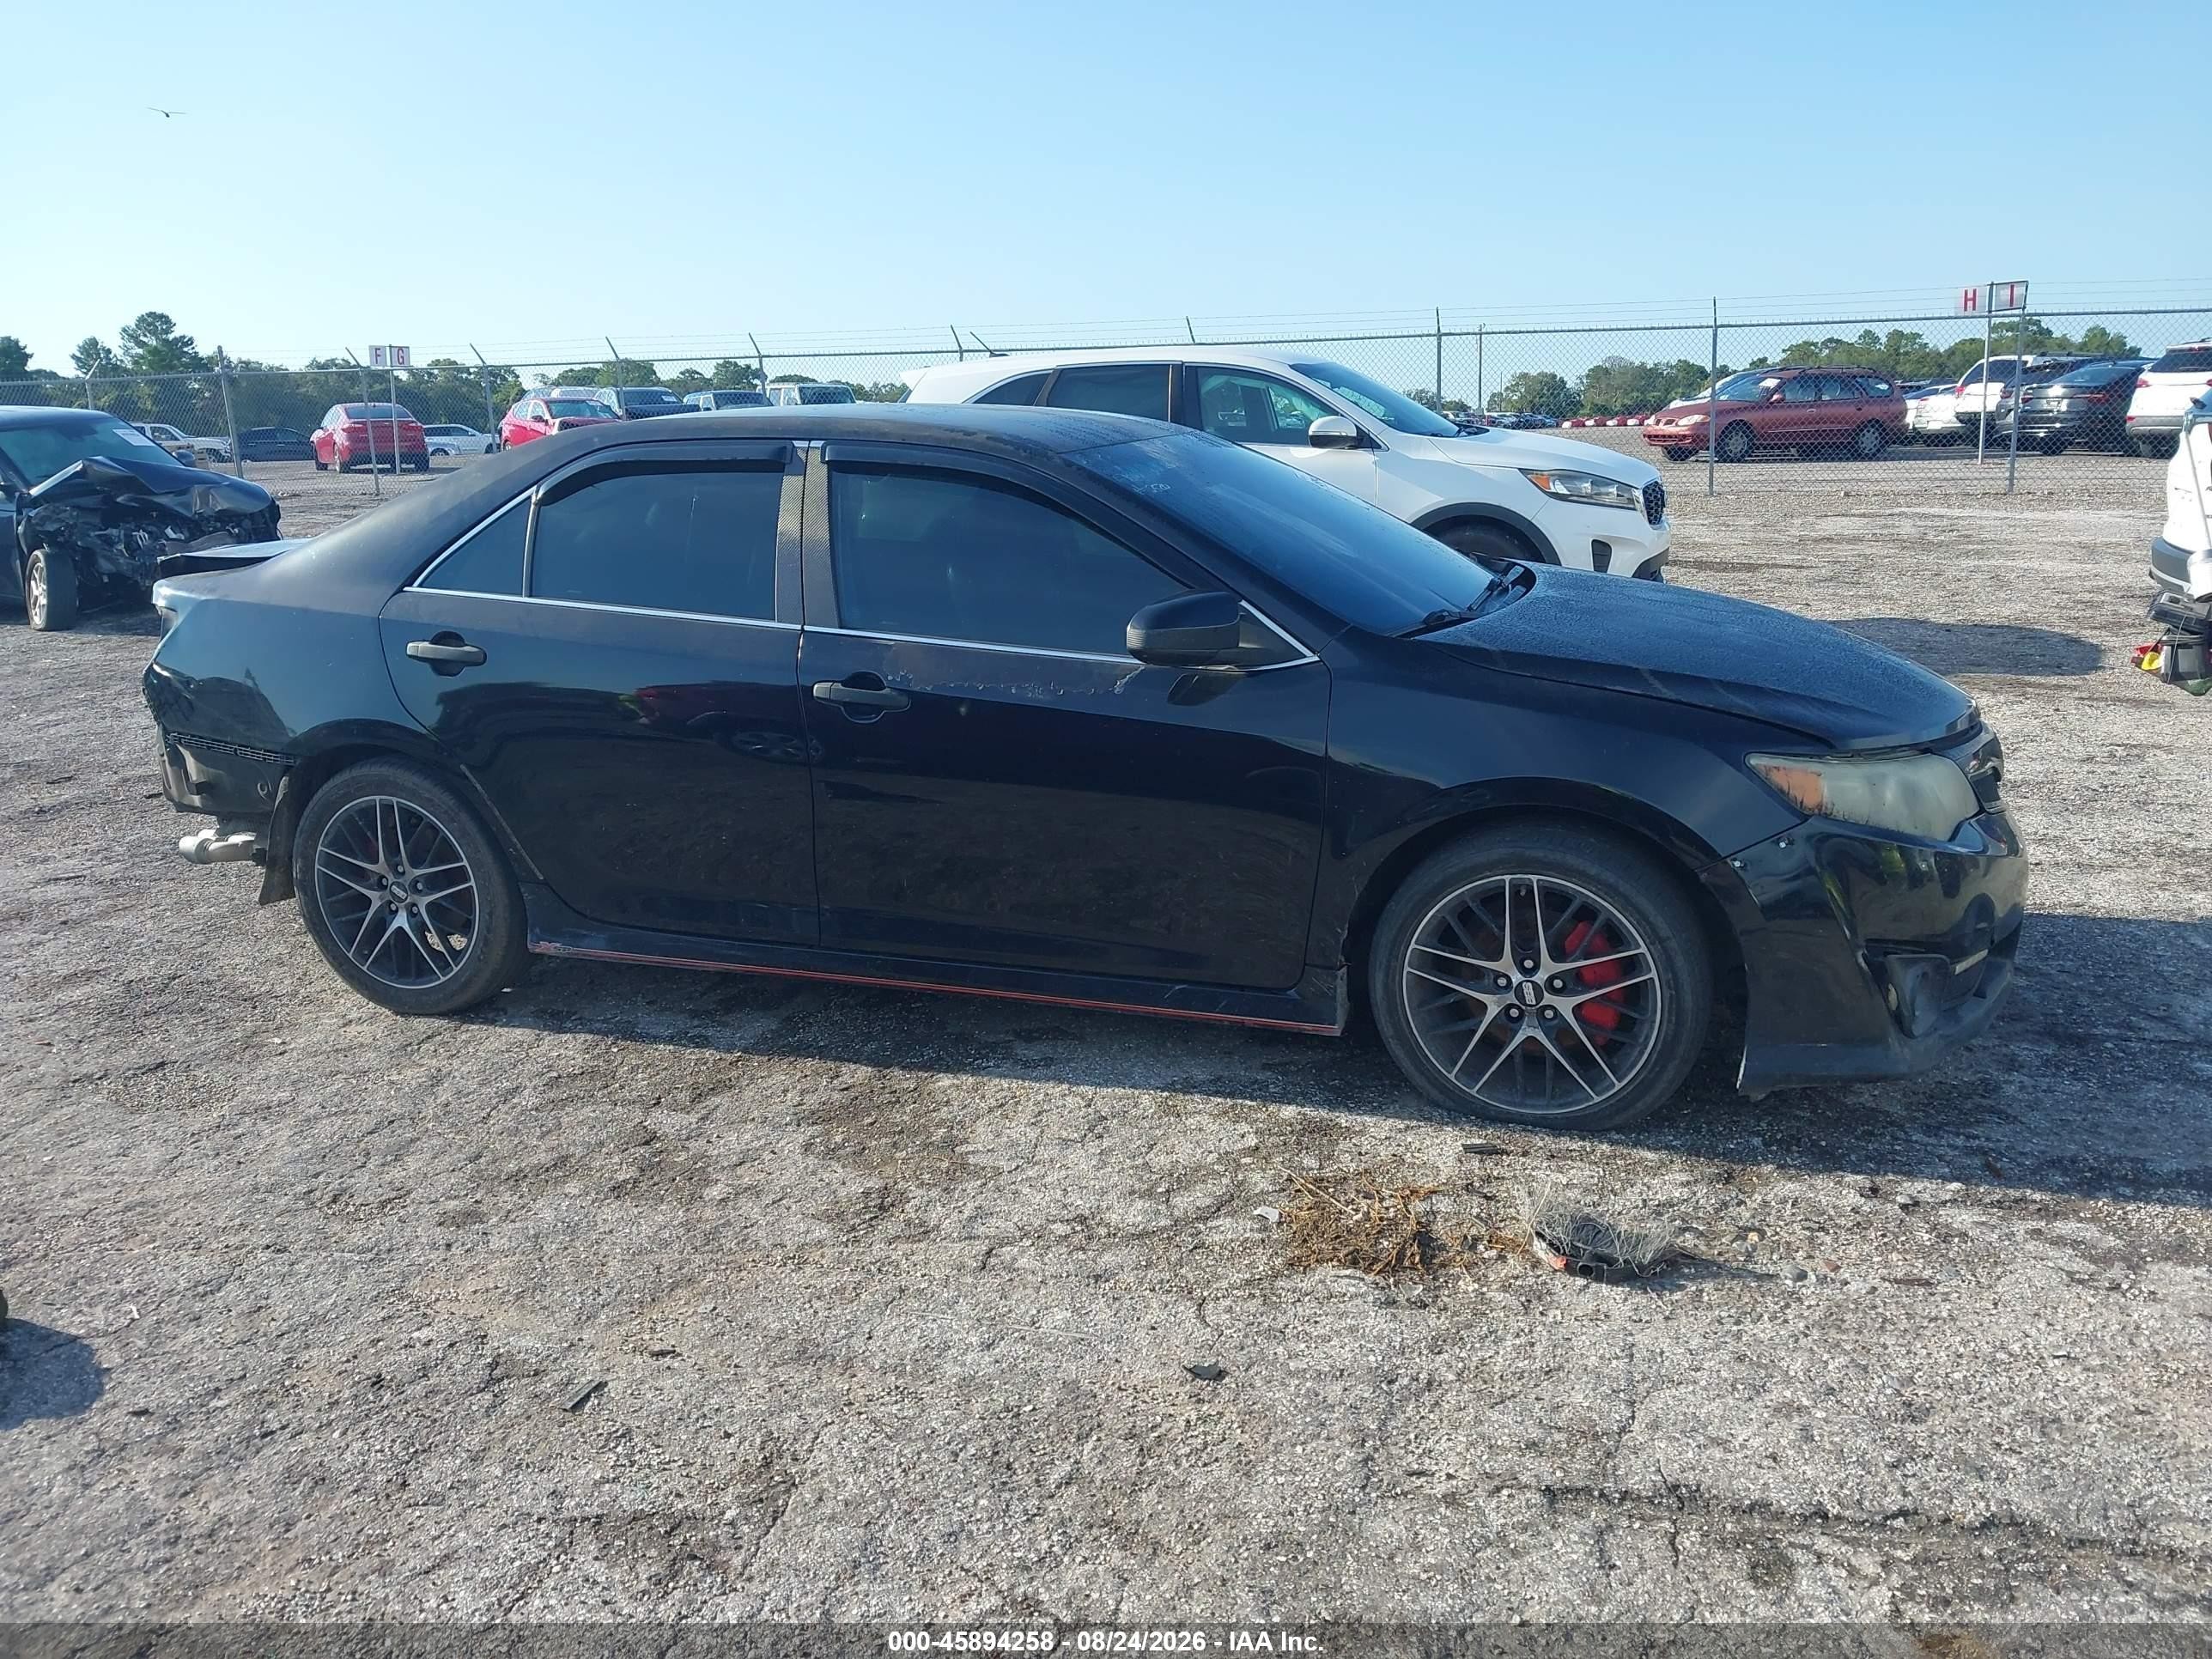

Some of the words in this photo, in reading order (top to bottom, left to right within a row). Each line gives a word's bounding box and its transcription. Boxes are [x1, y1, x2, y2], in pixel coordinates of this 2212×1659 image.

[1963, 289, 1978, 312] H
[374, 348, 381, 365] F
[397, 348, 405, 365] G
